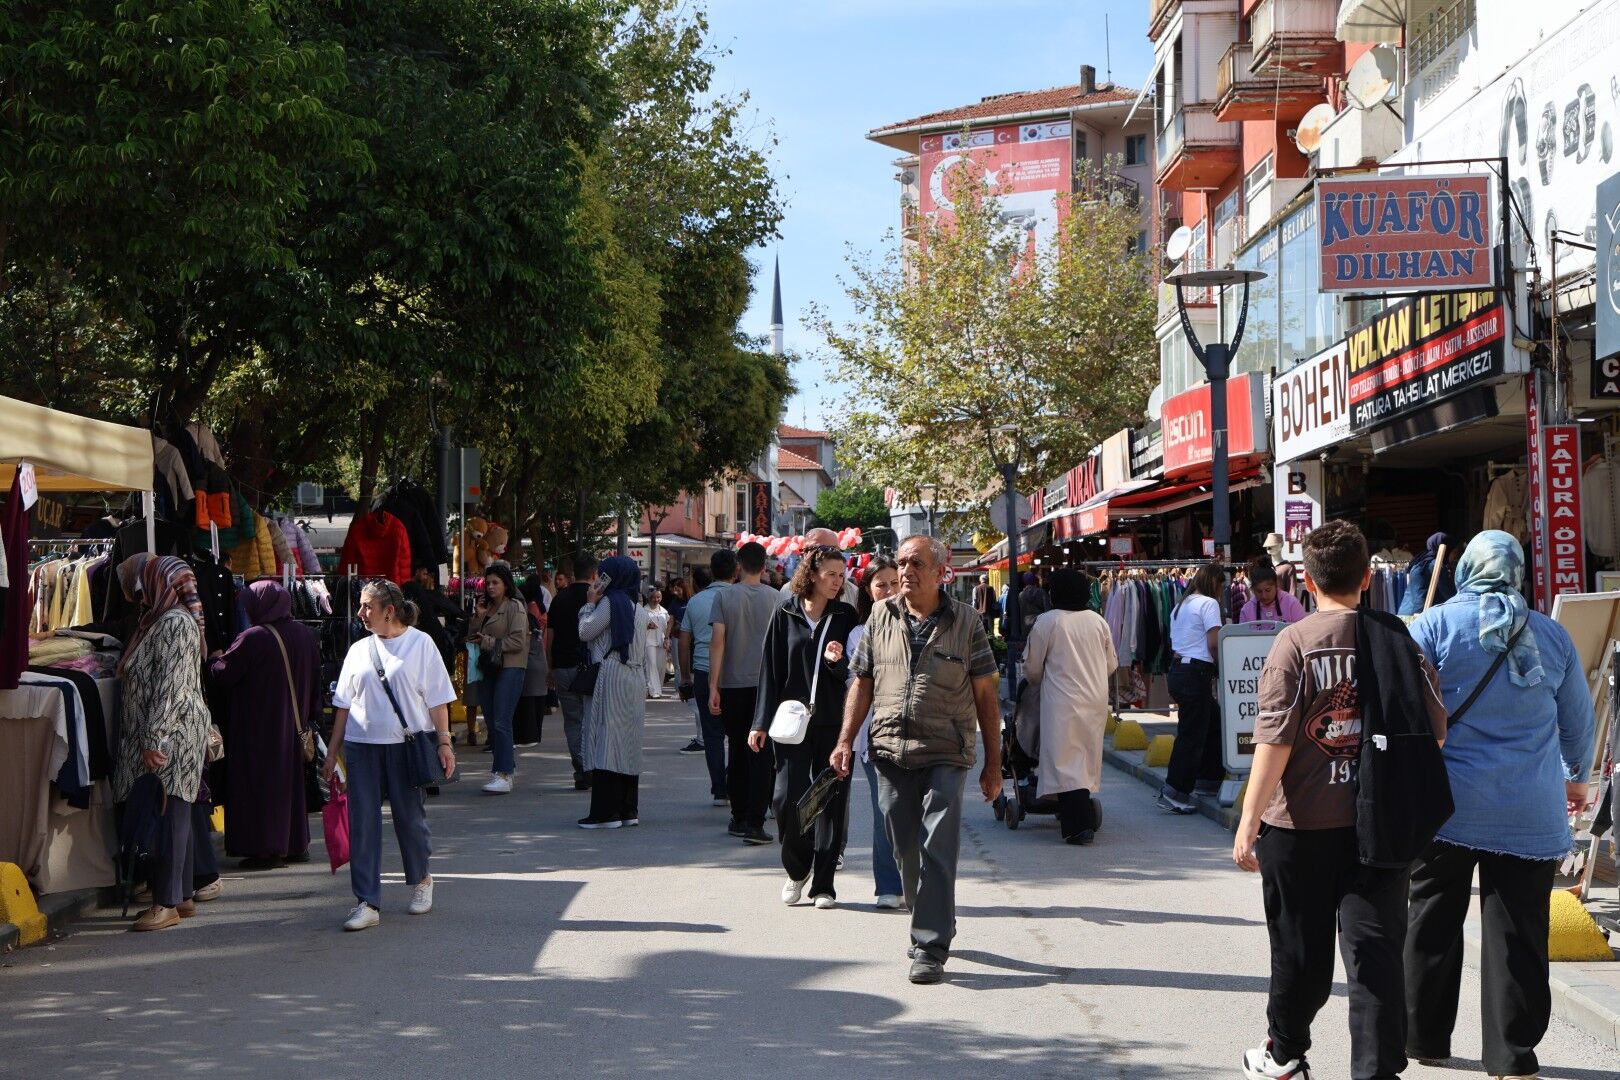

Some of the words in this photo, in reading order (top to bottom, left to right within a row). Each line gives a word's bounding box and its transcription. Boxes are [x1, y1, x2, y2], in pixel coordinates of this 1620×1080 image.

[1322, 178, 1485, 247] KUAFÖR
[1335, 242, 1476, 281] DİLHAN
[1348, 304, 1410, 373] VOLKAN
[1466, 316, 1498, 347] AKSESUAR
[1356, 394, 1392, 425] FATURA
[1528, 379, 1540, 485] FATURA
[1066, 456, 1097, 509] DURAK
[1551, 433, 1575, 518] FATURA
[1533, 495, 1545, 587] ÖDEME
[1328, 760, 1358, 785] 19
